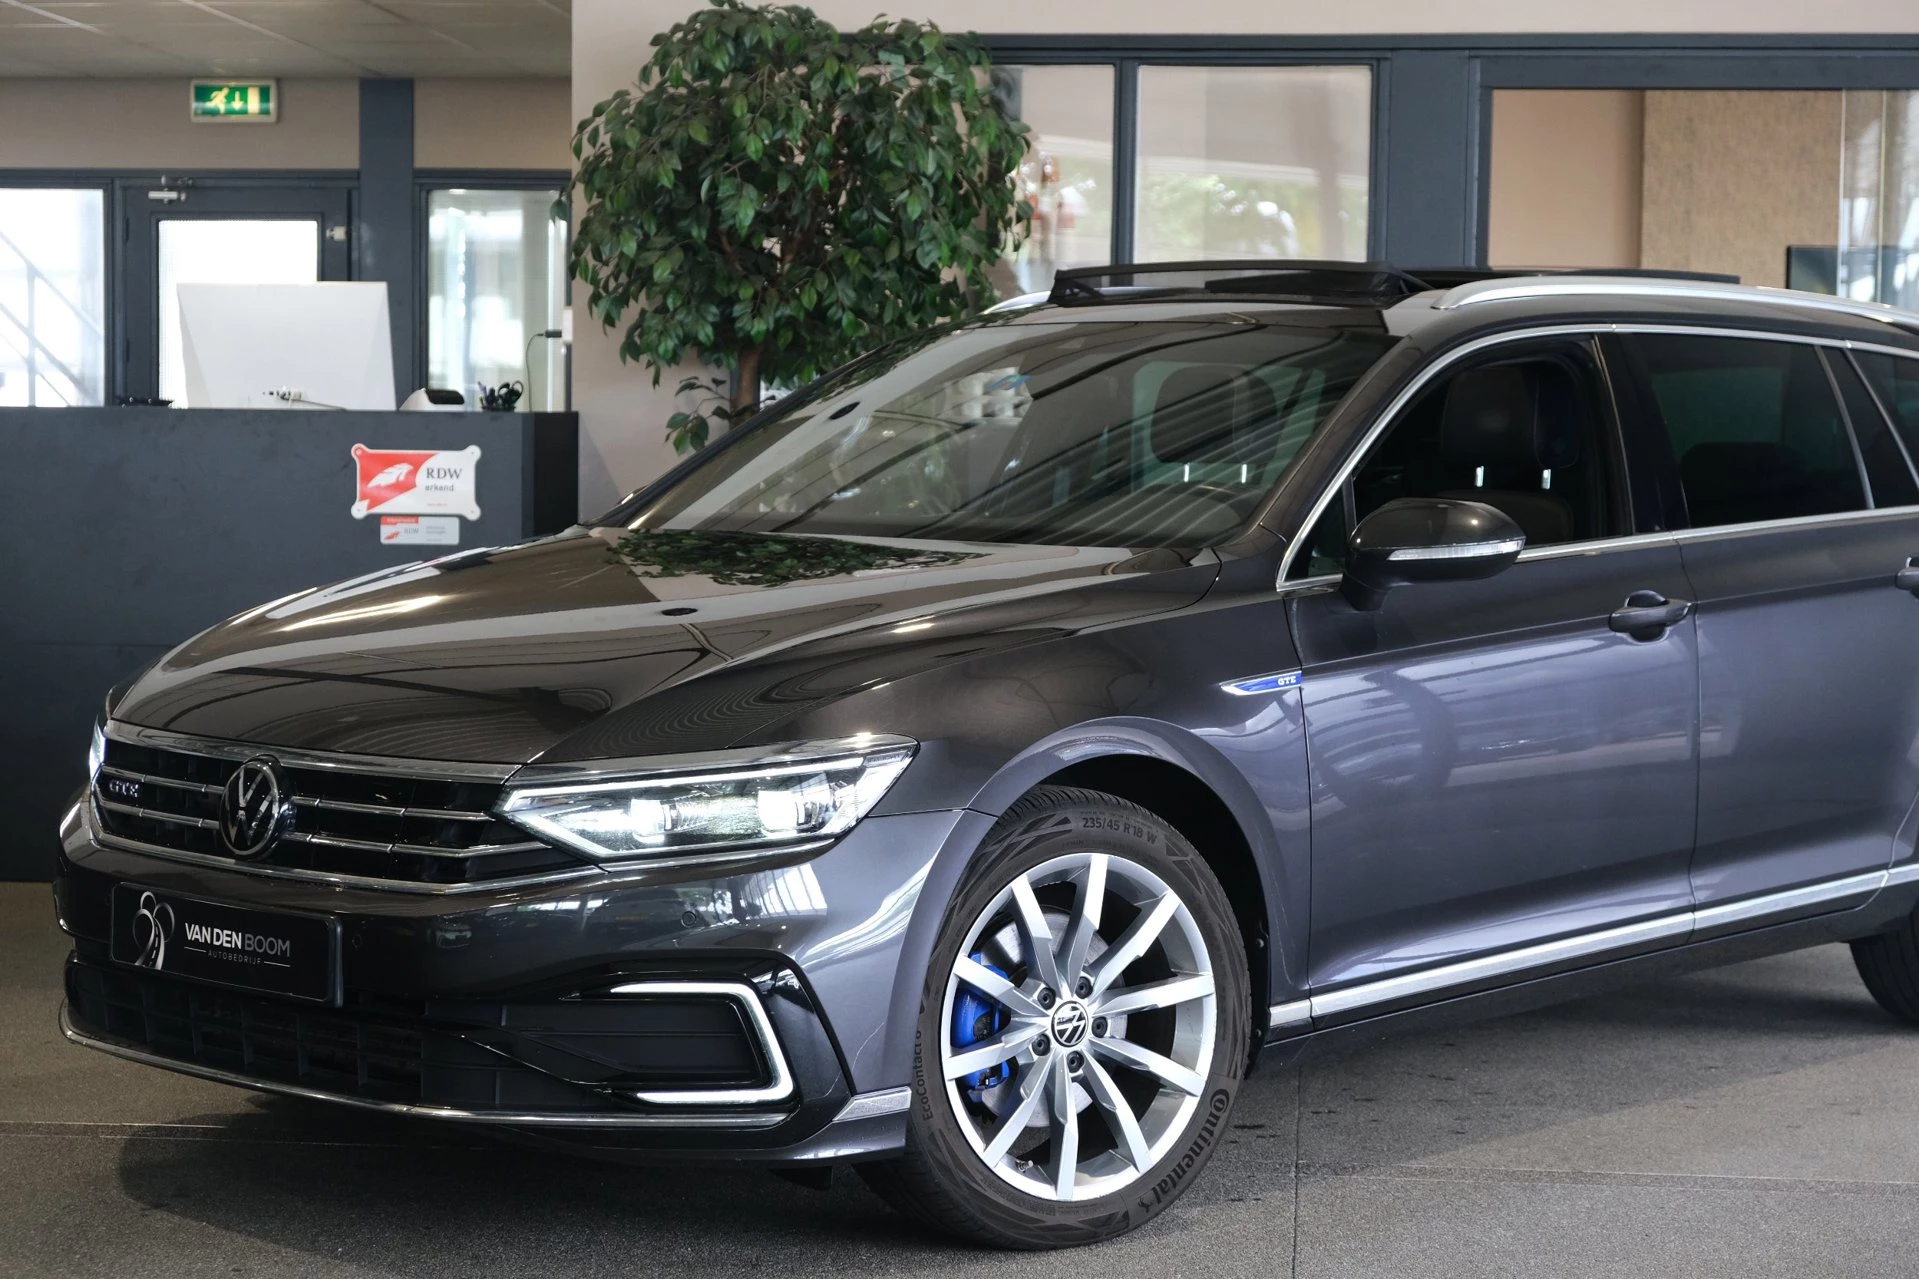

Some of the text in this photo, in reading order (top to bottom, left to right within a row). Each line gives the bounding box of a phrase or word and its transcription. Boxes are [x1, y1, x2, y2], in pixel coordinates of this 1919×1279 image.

[426, 467, 463, 480] RDW
[1277, 676, 1297, 686] GTE
[1082, 817, 1158, 845] 235/45 R 18 W
[184, 922, 290, 957] VAN DEN BOOM
[208, 950, 262, 965] AUTOBEDRIJF
[1151, 1088, 1230, 1204] Continental
